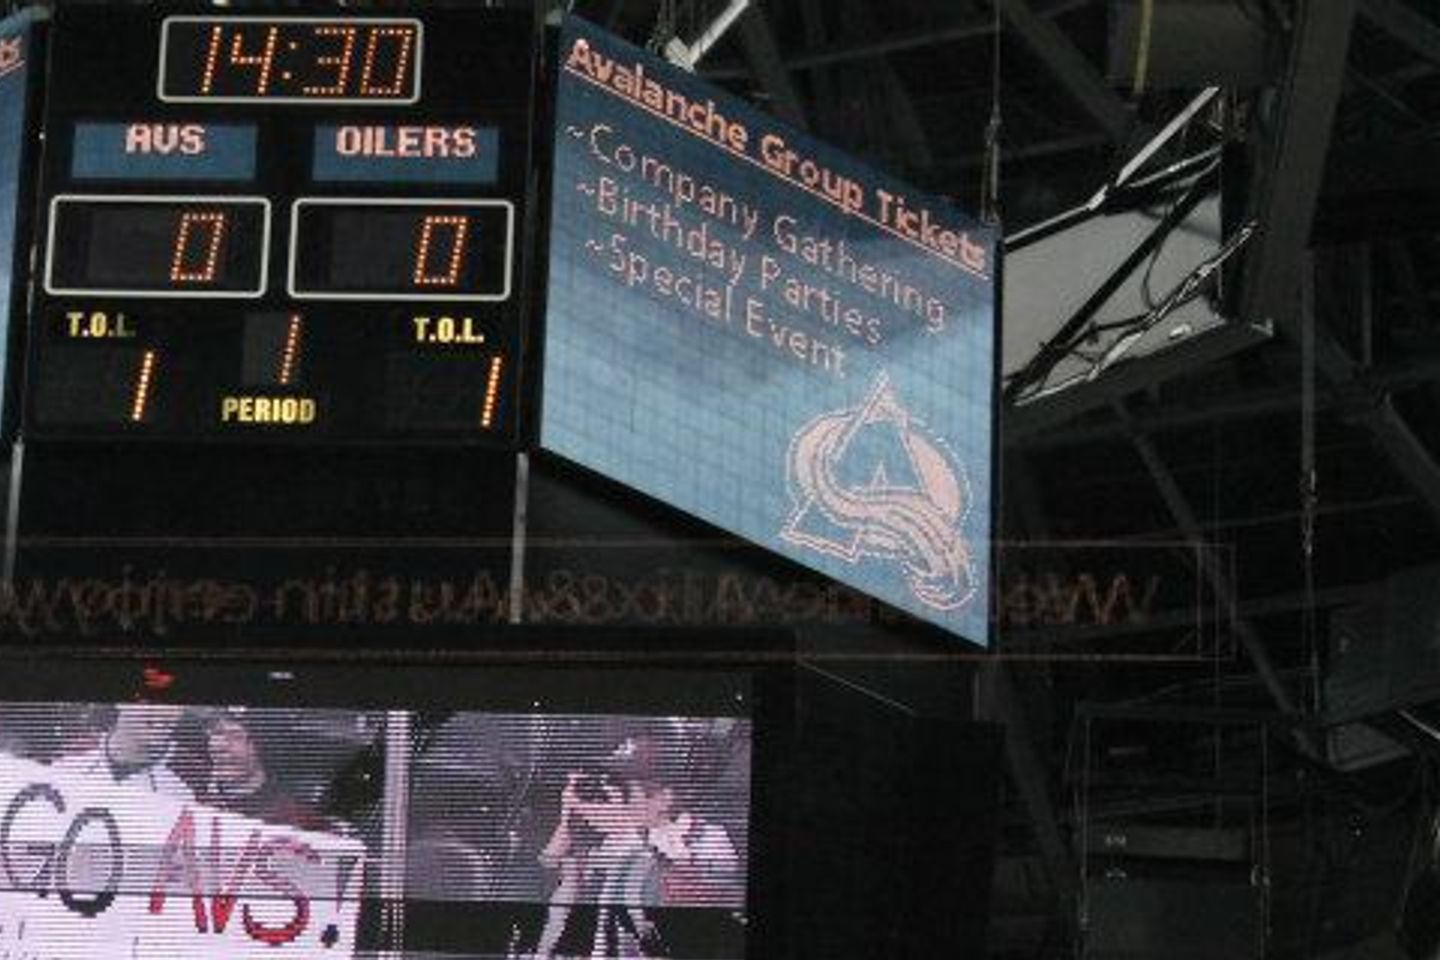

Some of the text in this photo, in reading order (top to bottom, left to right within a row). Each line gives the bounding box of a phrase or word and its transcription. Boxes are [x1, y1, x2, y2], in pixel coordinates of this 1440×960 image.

[202, 25, 414, 96] 14:30
[334, 124, 478, 159] OILERS
[566, 38, 987, 271] Avalanche Group Tickets
[170, 212, 225, 282] 0
[413, 215, 467, 285] 0
[773, 215, 946, 334] Gathering
[414, 317, 484, 343] T.O.L.
[760, 256, 882, 346] Parties
[279, 314, 302, 385] 1
[745, 298, 848, 378] Event
[131, 351, 155, 422] 1
[222, 397, 316, 424] PERIOD
[481, 355, 503, 429] 1
[0, 783, 364, 948] GO AVS!
